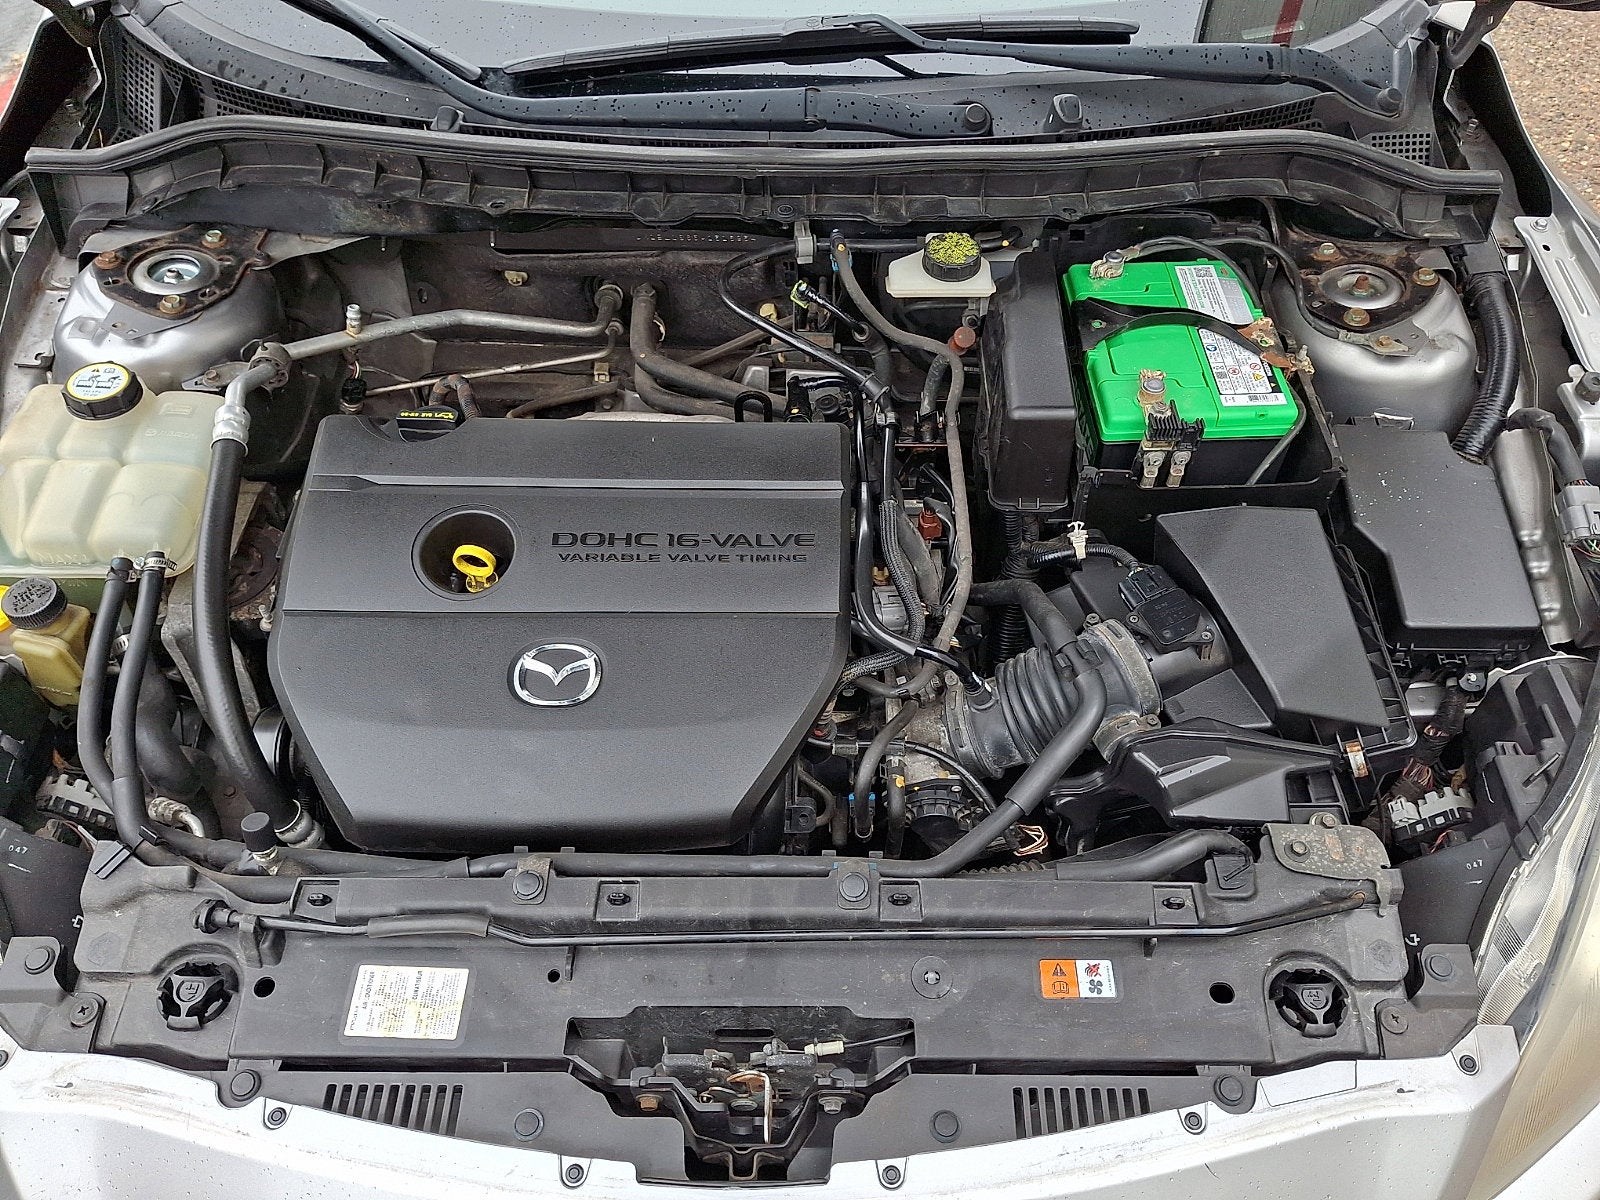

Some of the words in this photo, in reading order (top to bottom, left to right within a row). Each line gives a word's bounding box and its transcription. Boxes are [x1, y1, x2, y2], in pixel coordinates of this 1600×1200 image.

[550, 532, 659, 548] DOHC
[666, 532, 816, 548] 16-VALVE
[557, 553, 661, 563] VARIABLE
[667, 553, 730, 563] VALVE
[735, 553, 808, 563] TIMING
[8, 844, 28, 854] 047
[1466, 859, 1483, 870] 047
